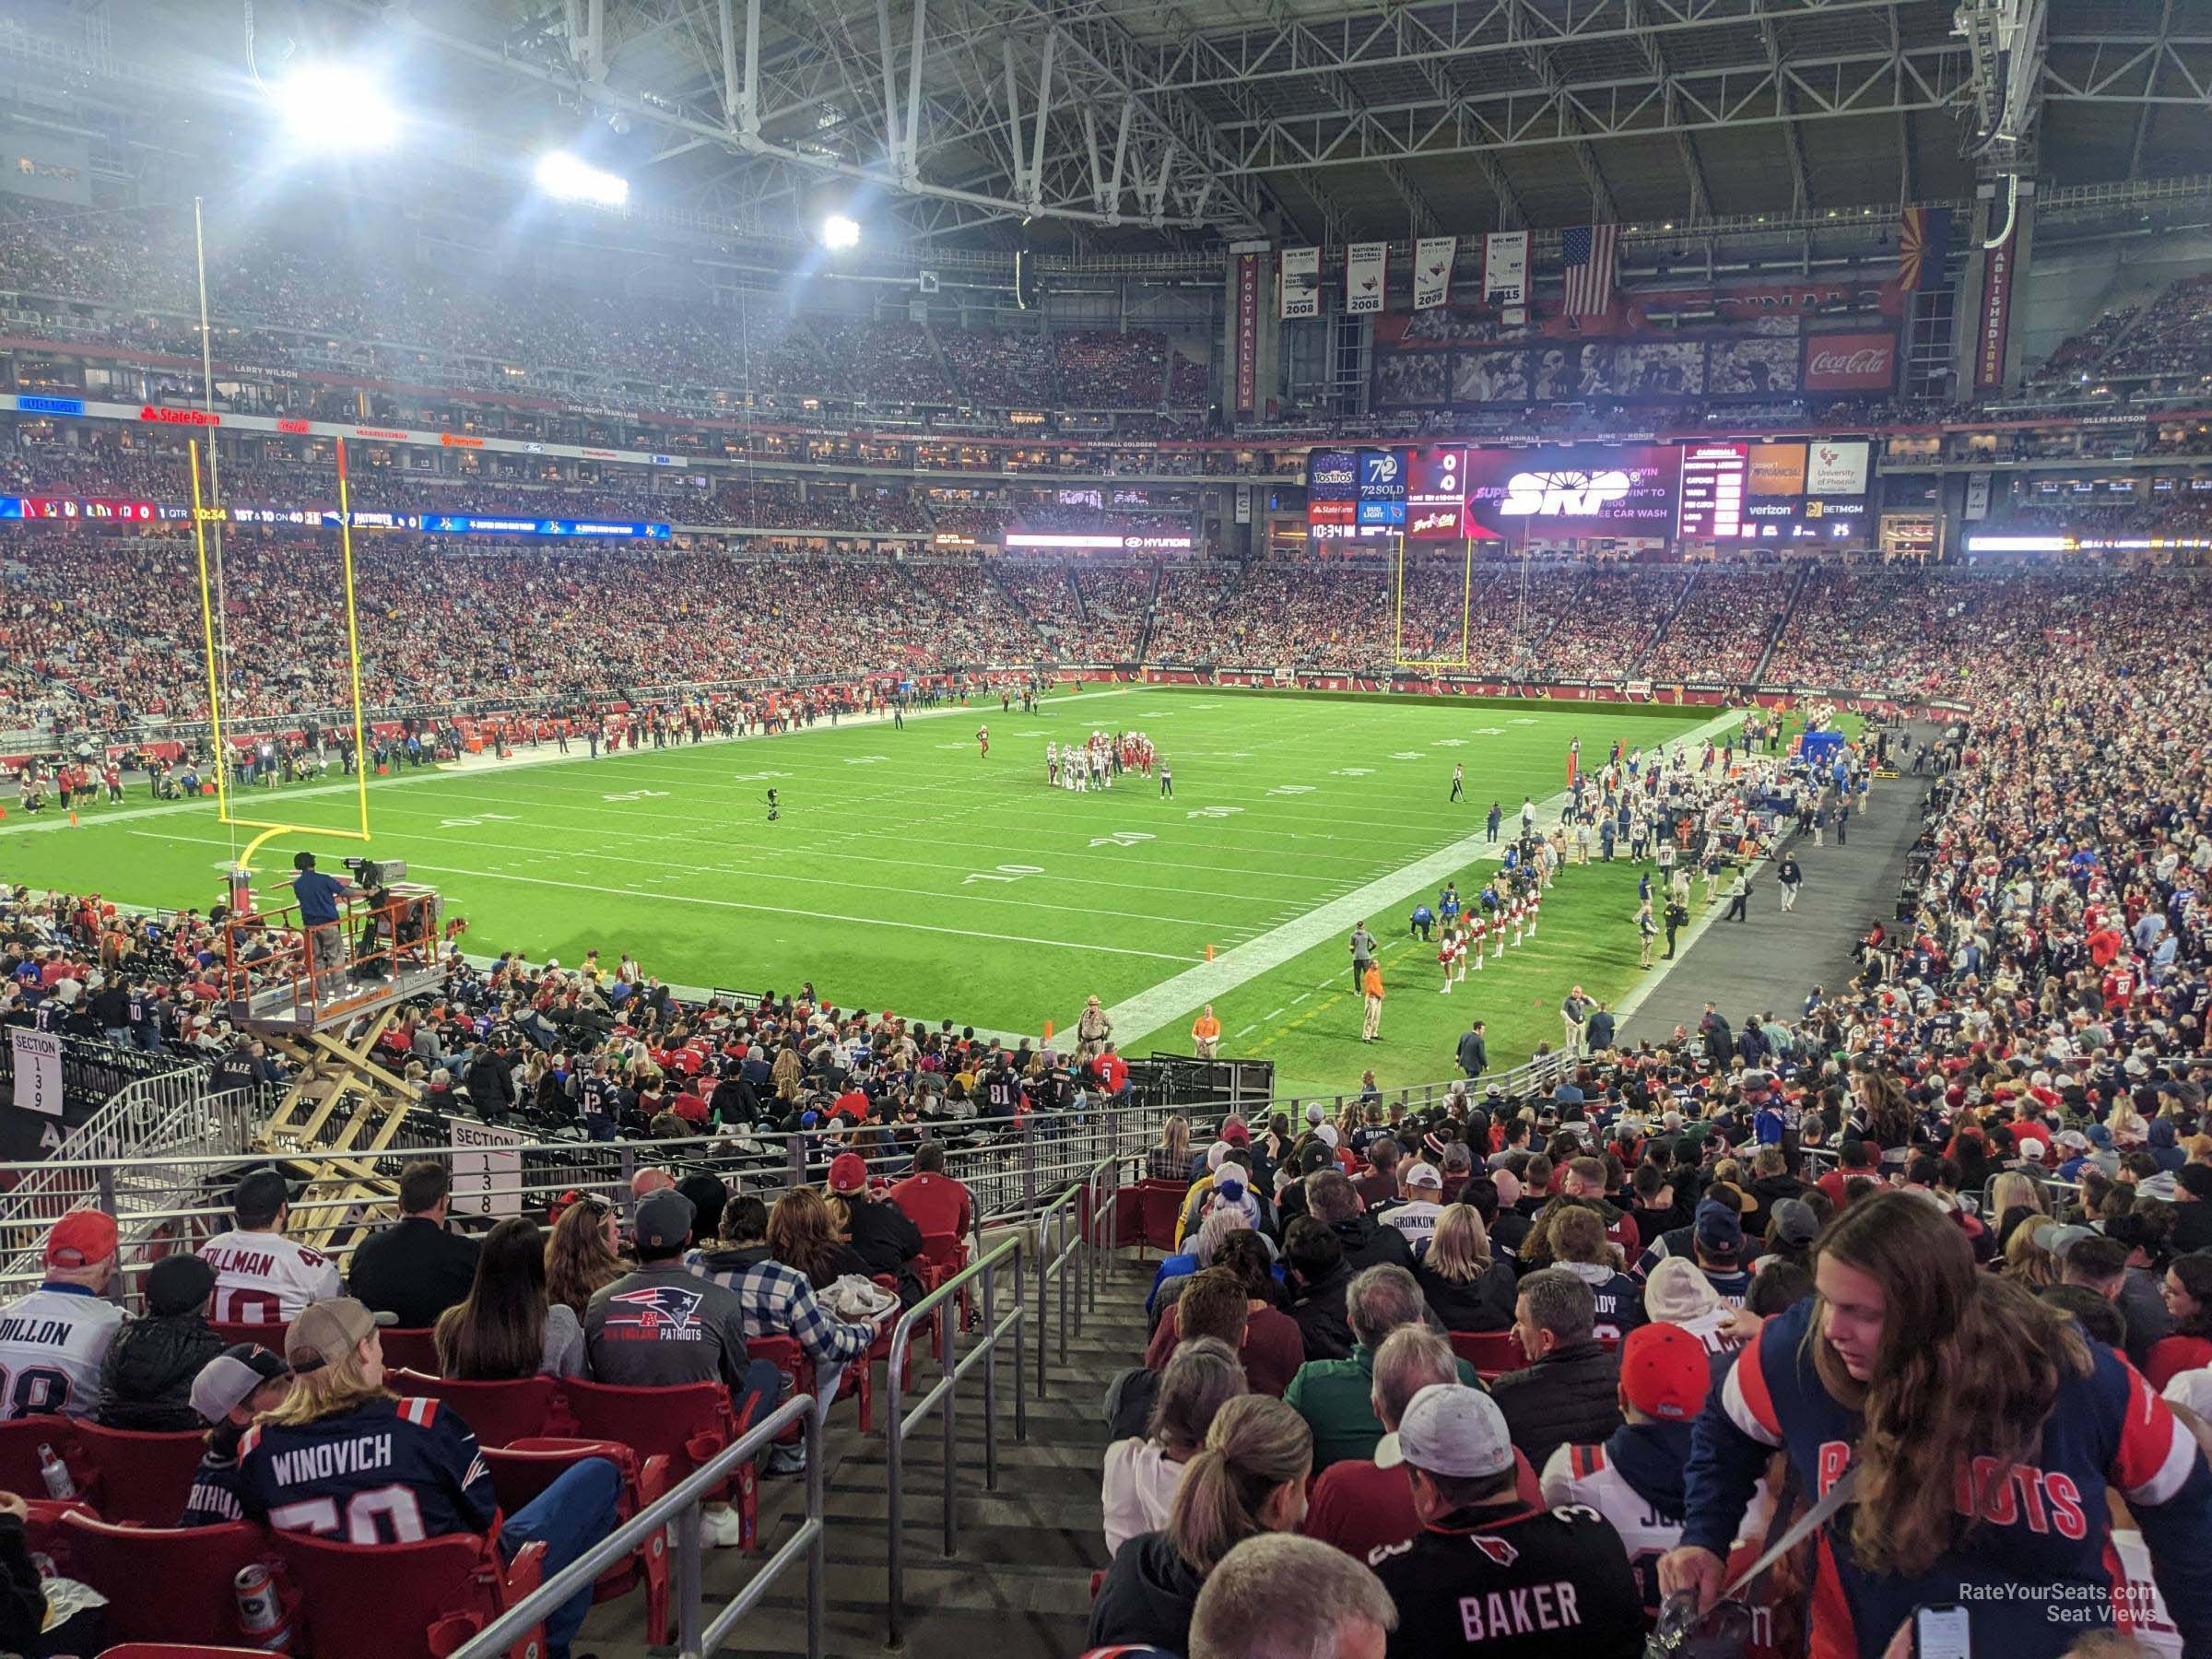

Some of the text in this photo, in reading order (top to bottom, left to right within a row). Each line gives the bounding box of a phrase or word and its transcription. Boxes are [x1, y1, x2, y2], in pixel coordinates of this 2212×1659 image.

[1351, 300, 1379, 310] 2008
[1418, 292, 1442, 305] 2009
[1286, 305, 1313, 314] 2008
[1985, 340, 1996, 382] 1898
[235, 364, 298, 379] LARRY WILSON
[2110, 415, 2147, 423] MATSON
[1370, 459, 1396, 483] 72
[1640, 468, 1658, 477] WIN
[1818, 469, 1855, 478] University
[1500, 471, 1630, 515] SRP
[1653, 488, 1665, 497] TO
[169, 509, 188, 519] QTR
[234, 509, 253, 521] 1ST
[276, 512, 288, 522] ON
[288, 512, 303, 524] 40
[1613, 510, 1634, 518] CAR
[1636, 510, 1667, 518] WASH
[1749, 504, 1791, 515] verizon
[1823, 505, 1864, 513] BETMGM
[354, 512, 393, 526] PATRIOTS
[1312, 524, 1343, 538] 10:34
[1144, 537, 1191, 547] HYUNDAI
[1186, 805, 1245, 819] 30
[1087, 830, 1157, 849] 20
[960, 864, 1045, 885] 10
[1920, 961, 1928, 974] 9
[2117, 981, 2130, 994] 87
[129, 1004, 142, 1021] 10
[15, 1034, 56, 1056] SECTION
[223, 1061, 252, 1075] S.A.F.E.
[1053, 1072, 1071, 1082] MURRAY
[990, 1084, 1010, 1104] 81
[1056, 1082, 1063, 1098] 1
[583, 1090, 602, 1114] 12
[456, 1127, 513, 1147] SECTION
[1394, 1215, 1438, 1230] GRONKOW
[202, 1246, 275, 1277] TILLMAN
[1593, 1295, 1617, 1313] ADY
[0, 1318, 73, 1347] DILLON
[660, 1328, 701, 1341] PATRIOTS
[0, 1364, 73, 1419] 8
[272, 1433, 392, 1488] WINOVICH
[1458, 1581, 1583, 1643] BAKER
